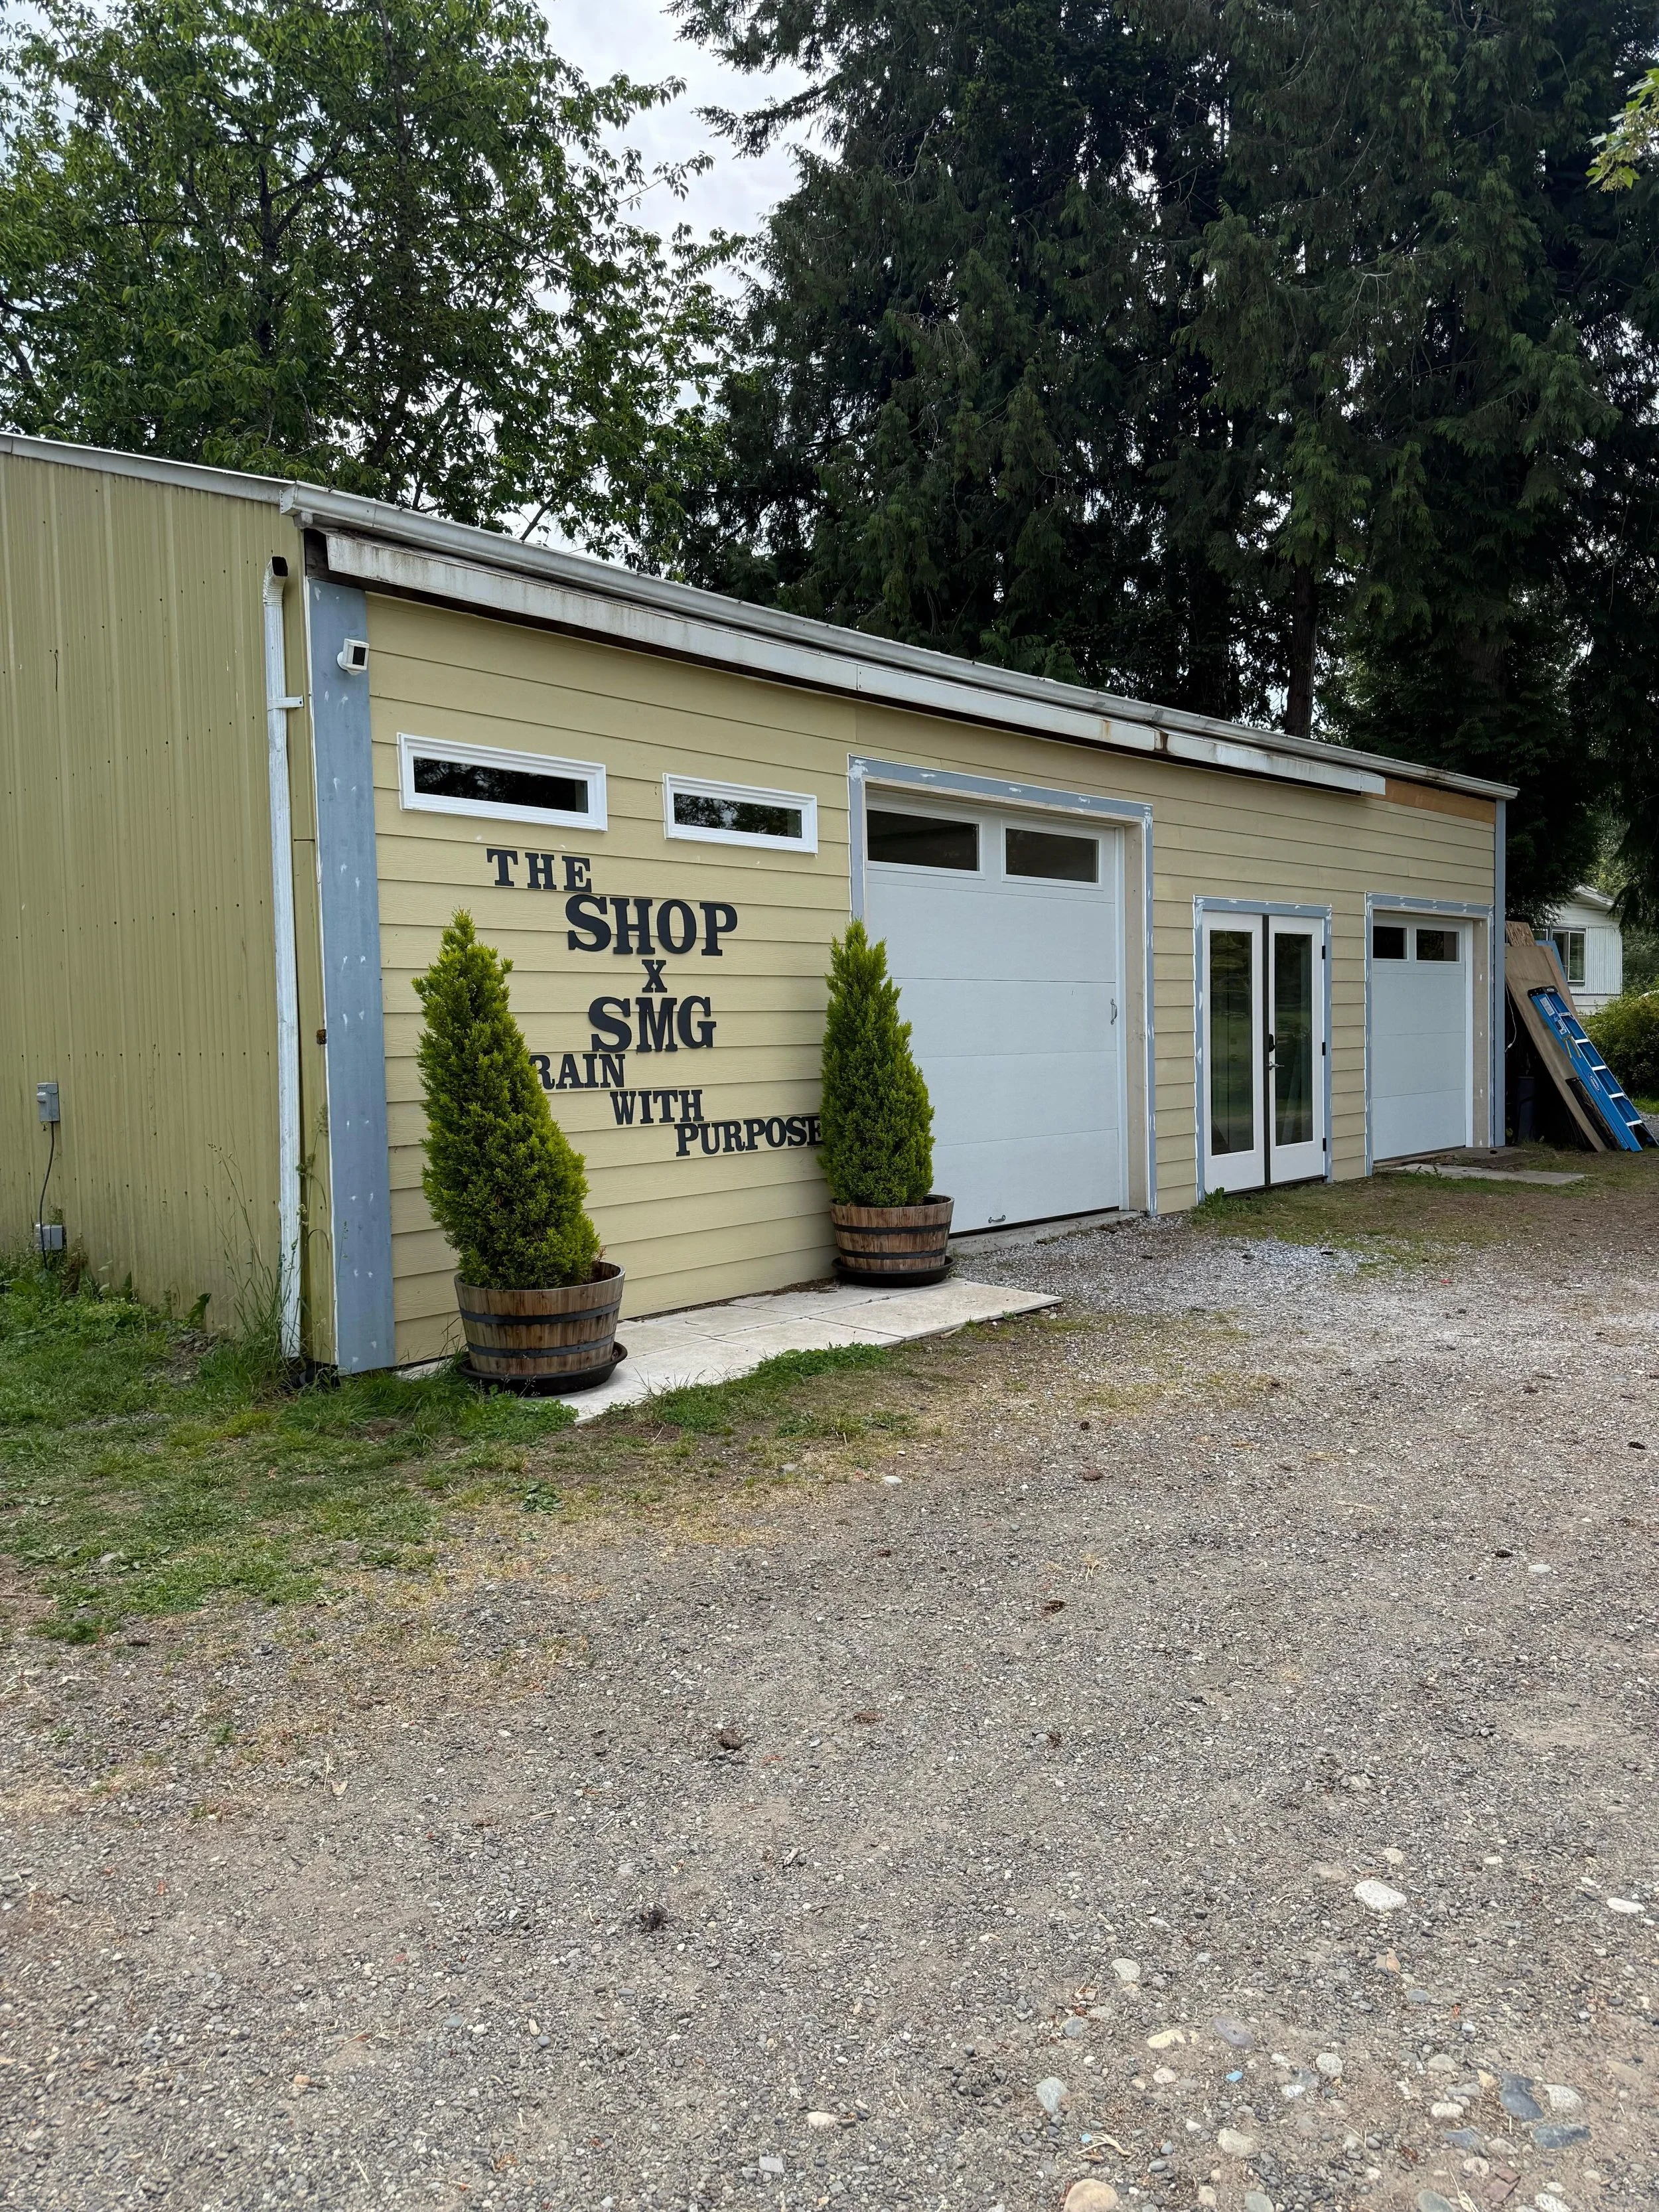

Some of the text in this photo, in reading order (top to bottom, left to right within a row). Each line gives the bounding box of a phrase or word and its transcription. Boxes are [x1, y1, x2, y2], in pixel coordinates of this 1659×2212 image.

[486, 848, 592, 893] THE
[565, 894, 738, 956] SHOP
[641, 959, 668, 993] X
[588, 995, 717, 1054] SMG
[529, 1053, 626, 1090] RAIN
[609, 1090, 705, 1125] WITH
[674, 1116, 825, 1157] PURPOSE
